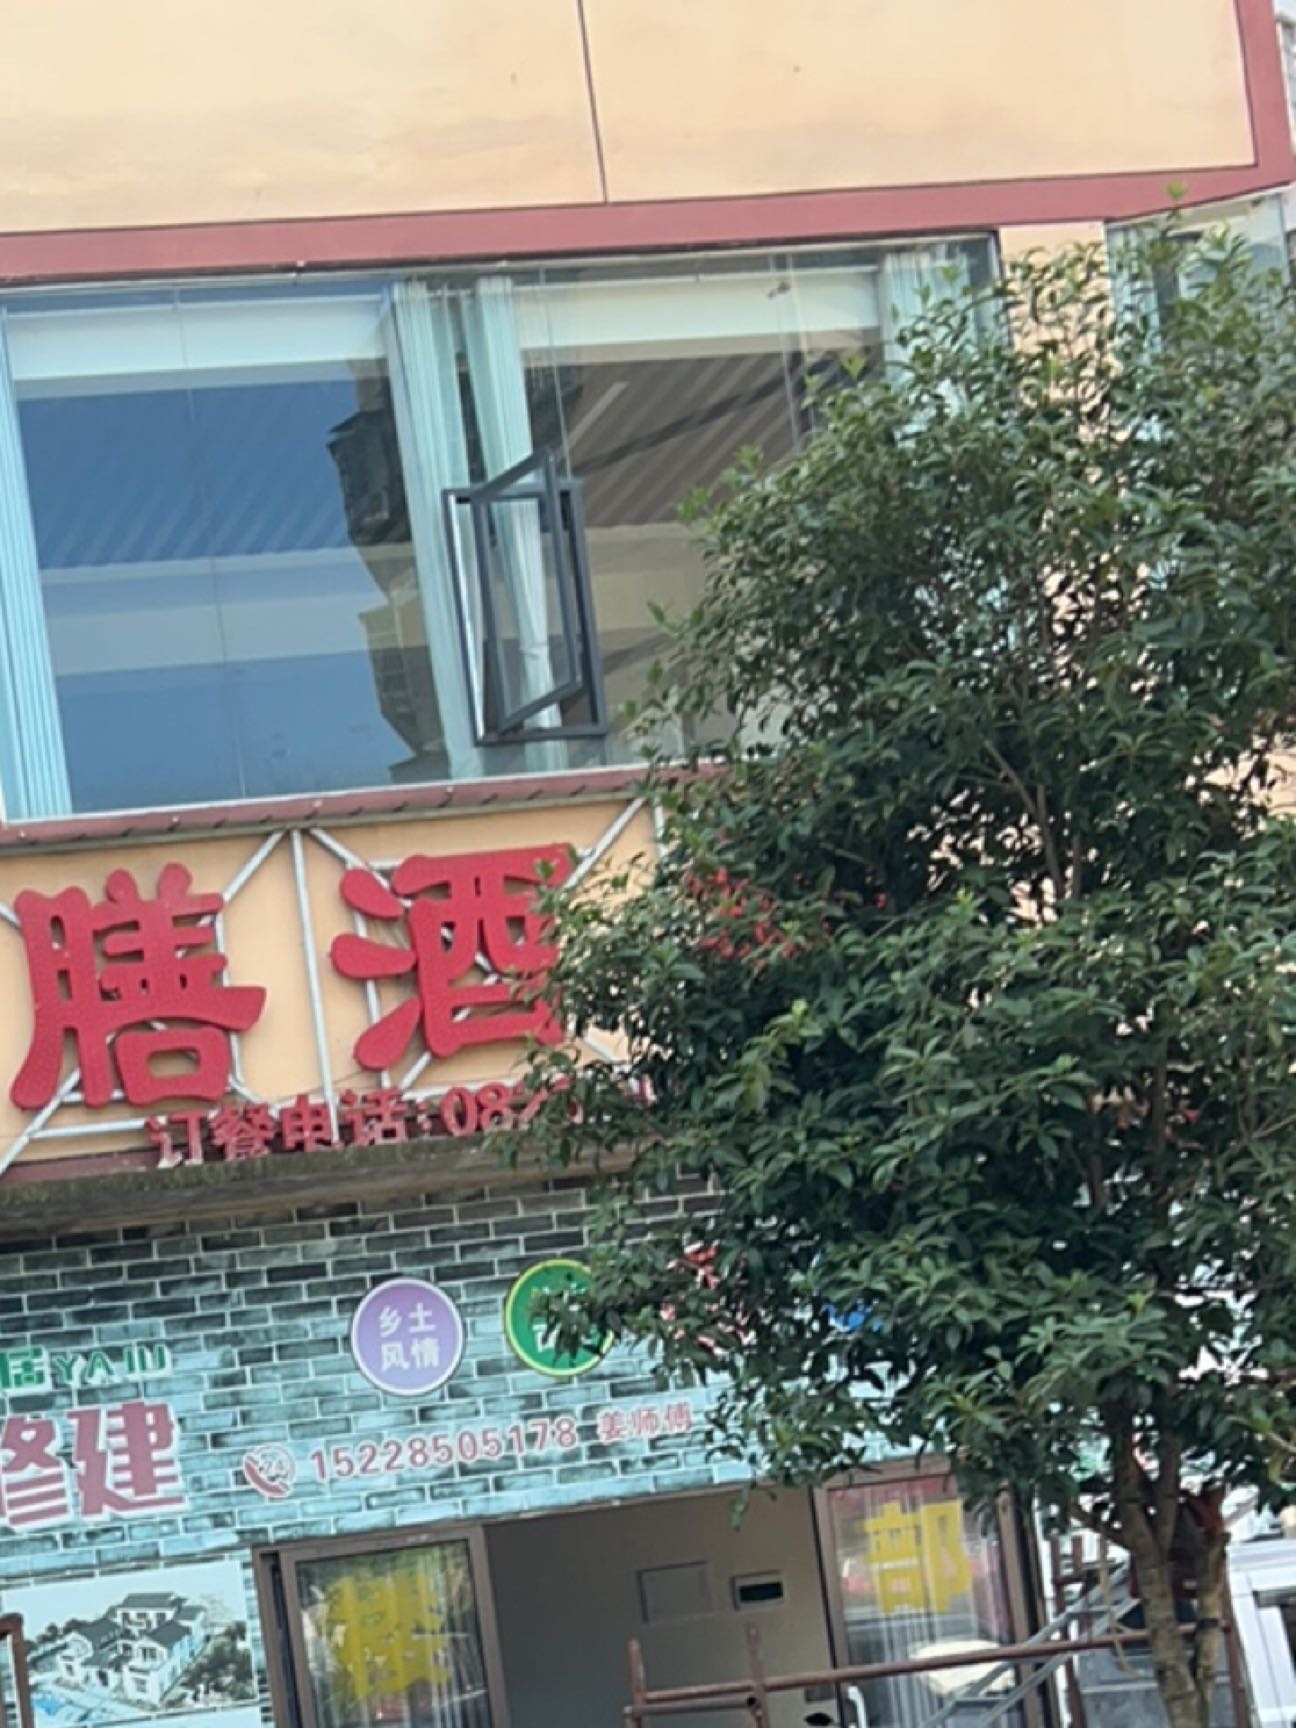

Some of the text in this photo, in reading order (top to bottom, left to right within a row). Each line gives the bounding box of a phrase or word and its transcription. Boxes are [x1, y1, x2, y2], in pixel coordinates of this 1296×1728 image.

[378, 1302, 438, 1338] 乡土
[380, 1336, 441, 1373] 风情
[310, 1416, 579, 1482] 15228505178
